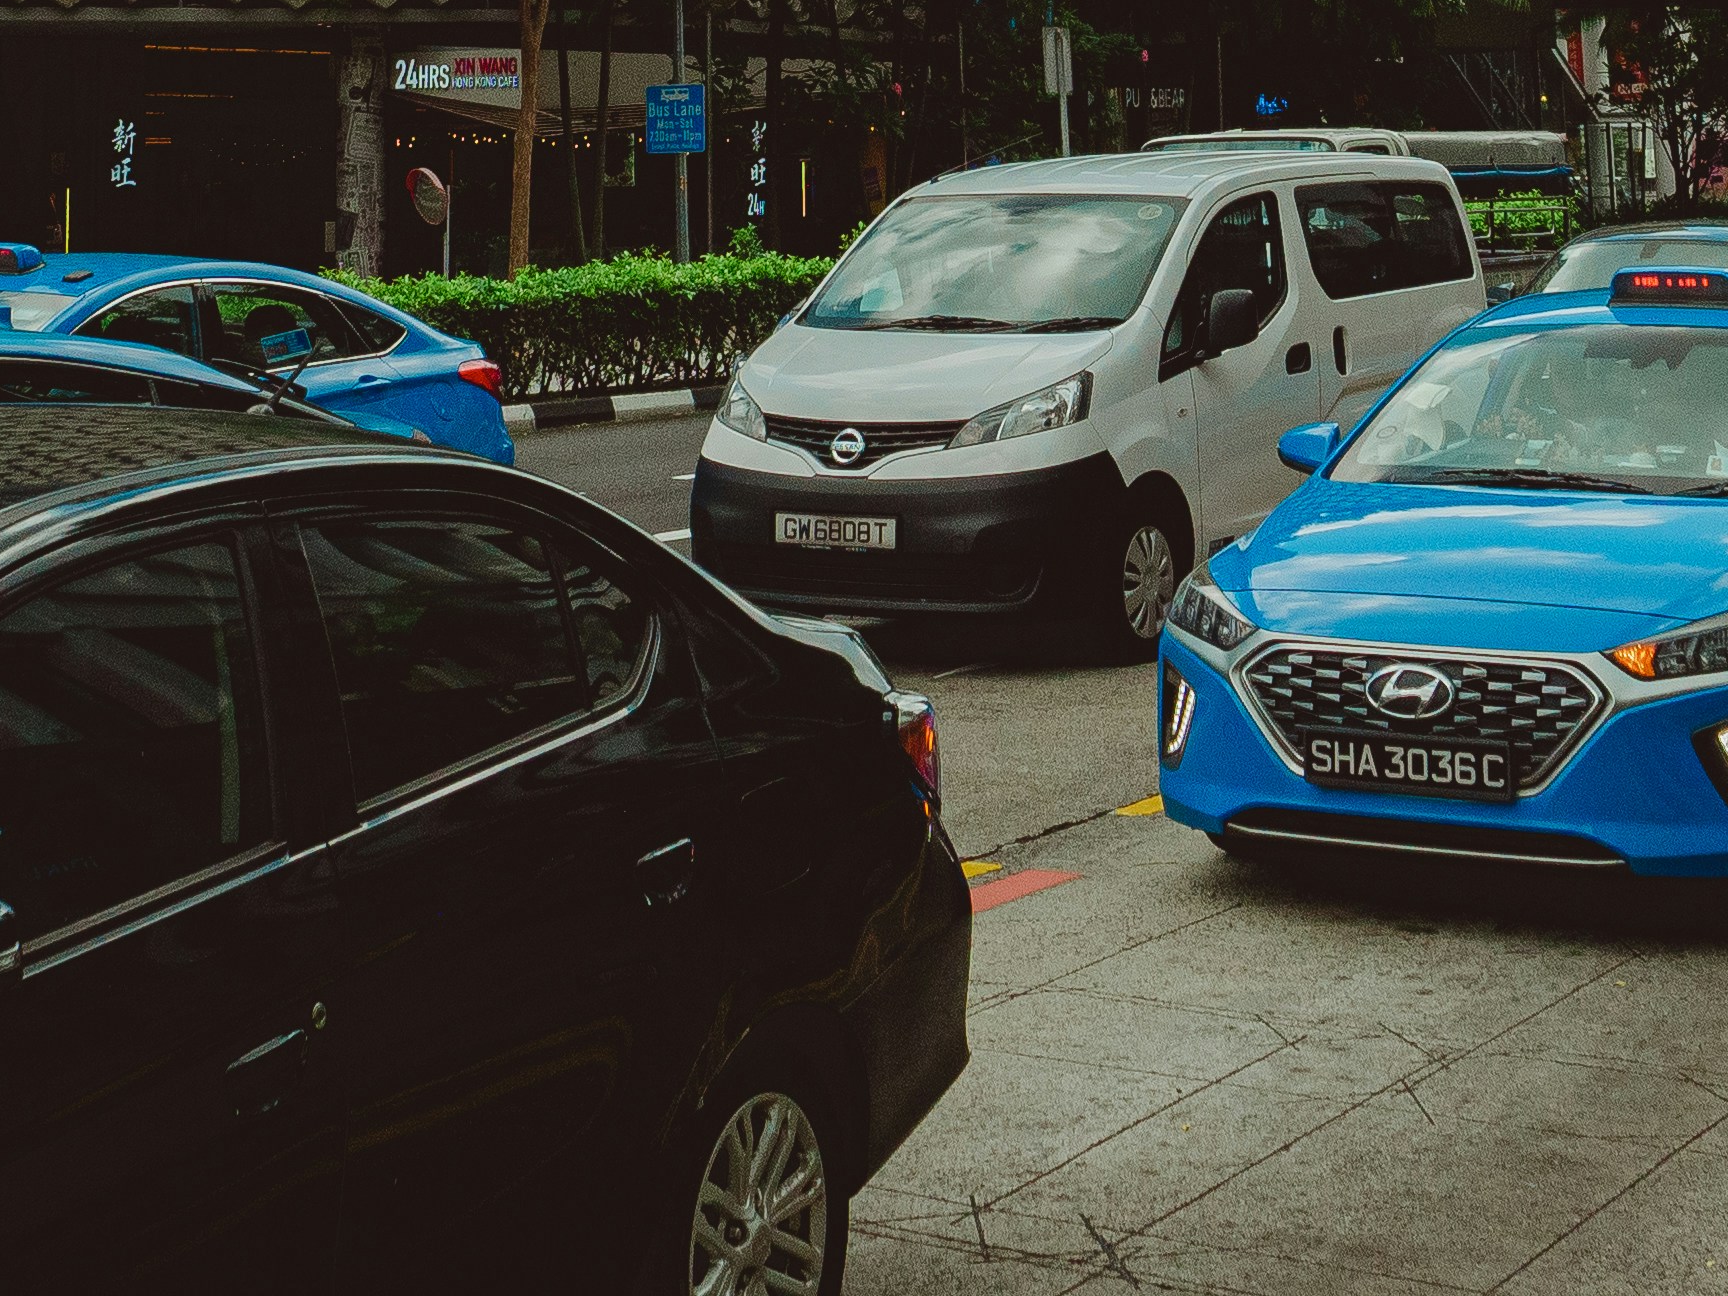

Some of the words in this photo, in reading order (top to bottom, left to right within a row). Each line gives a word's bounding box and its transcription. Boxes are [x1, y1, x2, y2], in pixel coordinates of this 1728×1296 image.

[394, 58, 450, 90] 24HRS
[454, 58, 475, 75] XIN
[479, 57, 517, 75] WANG
[475, 76, 497, 88] KONG
[498, 76, 518, 88] CAFE
[648, 102, 670, 117] Bus
[674, 101, 702, 116] Lane
[111, 119, 136, 187] 新旺
